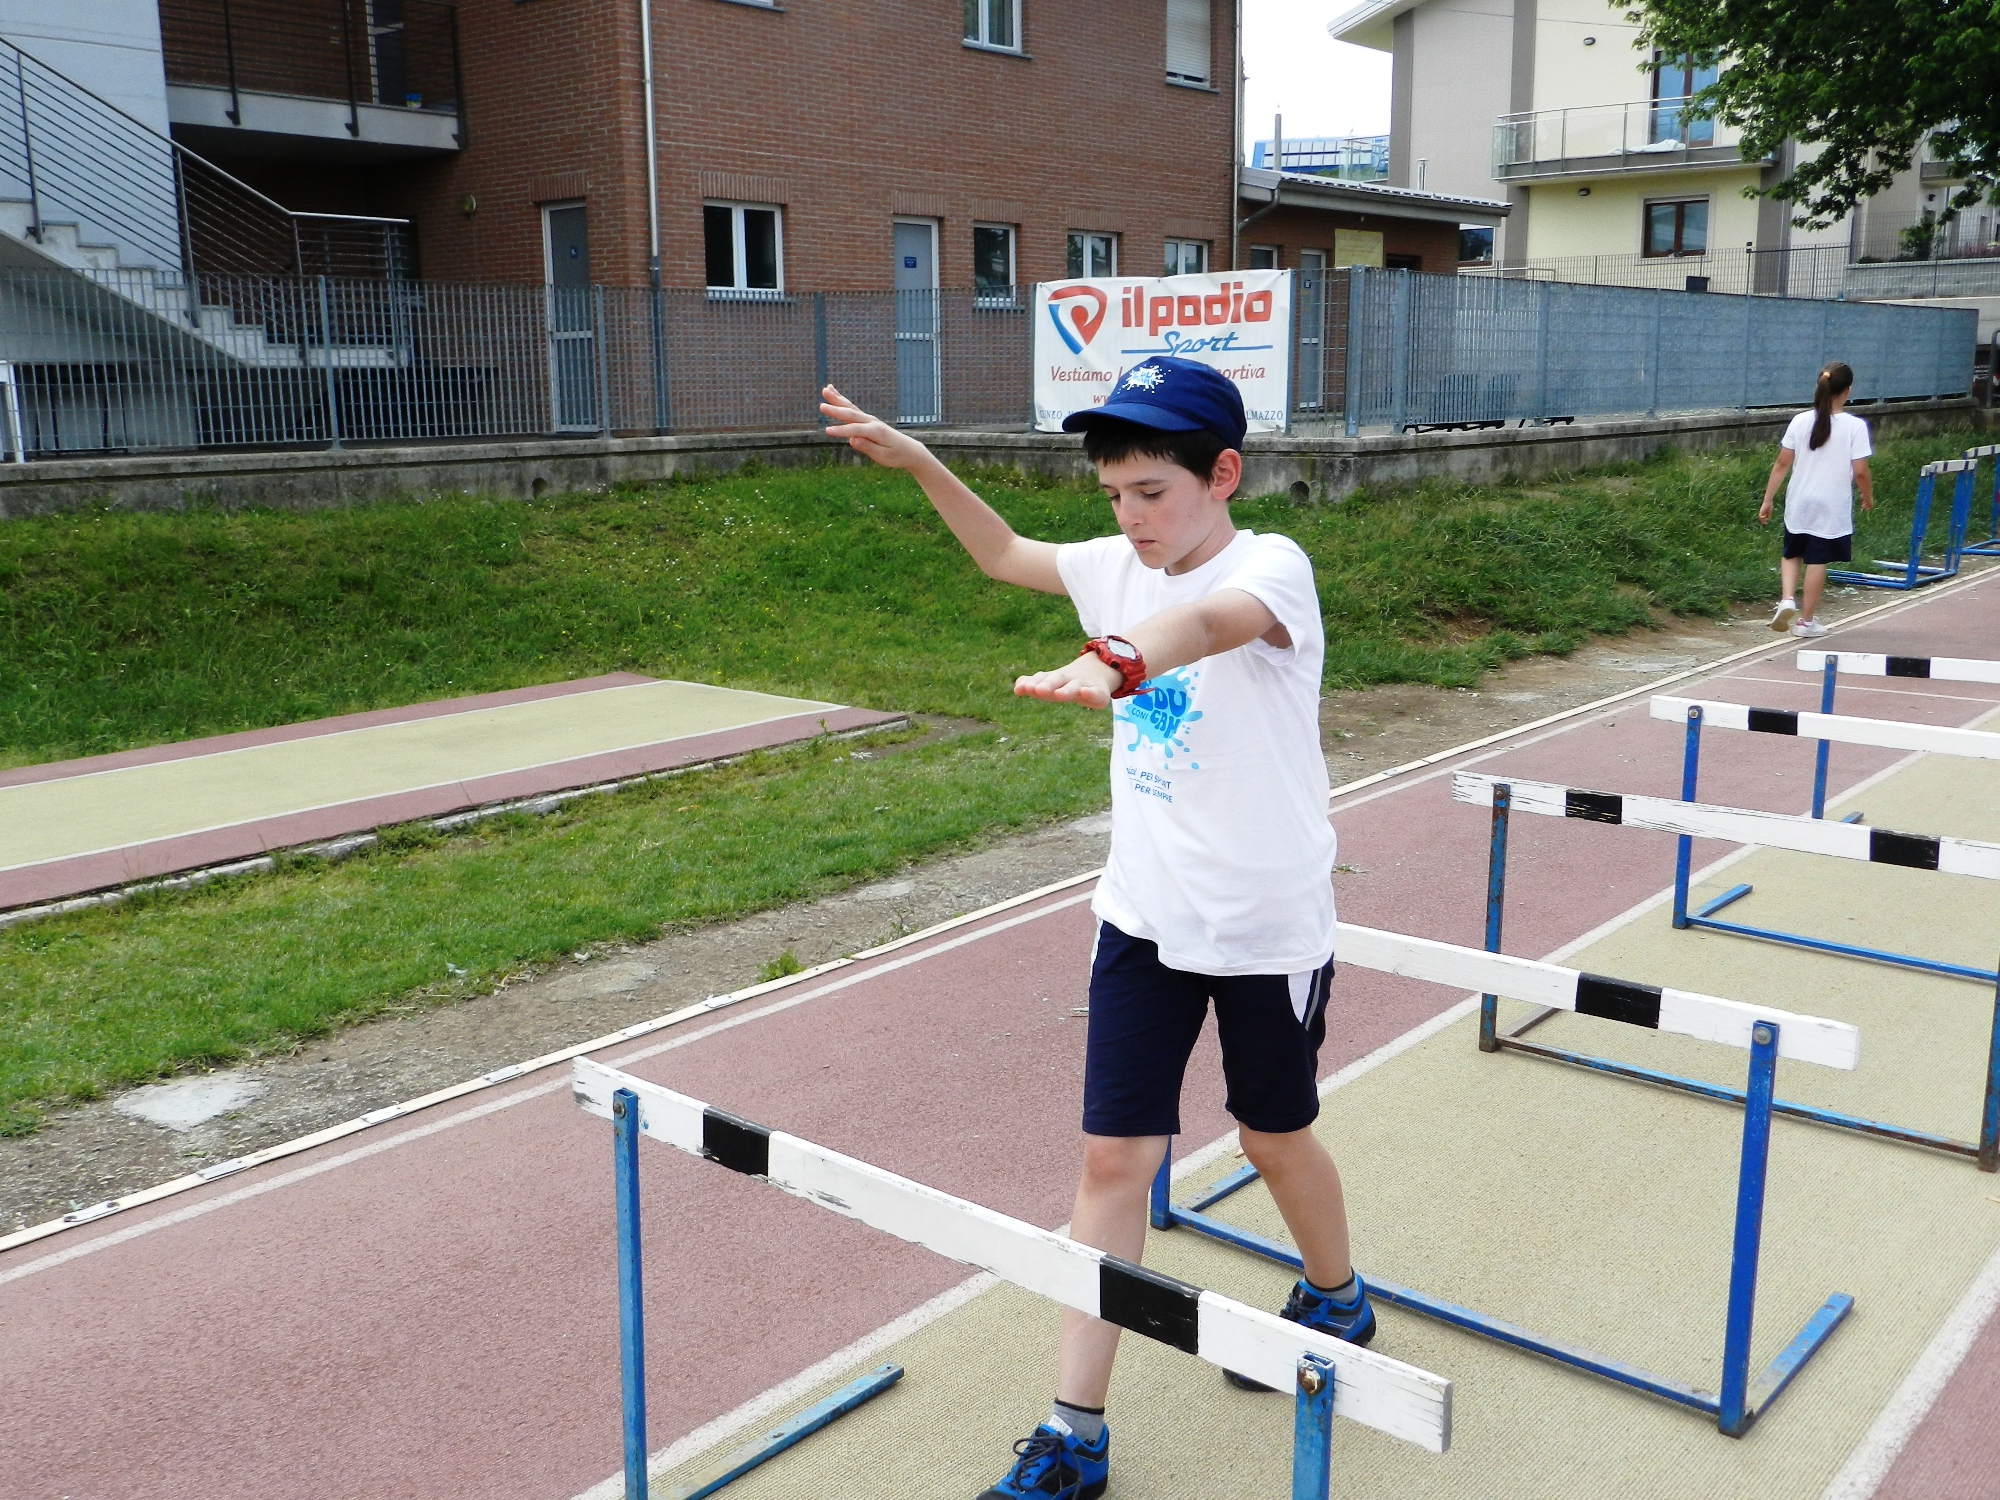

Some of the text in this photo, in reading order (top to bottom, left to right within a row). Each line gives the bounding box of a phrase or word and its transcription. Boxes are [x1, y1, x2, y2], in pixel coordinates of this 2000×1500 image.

[1164, 330, 1240, 357] Sport
[1051, 365, 1113, 381] Vestiamo
[1216, 363, 1265, 379] ortiva
[1246, 410, 1284, 421] LMAZZO
[1131, 707, 1149, 721] CONI
[1150, 709, 1181, 739] CAM
[1134, 783, 1151, 795] PER
